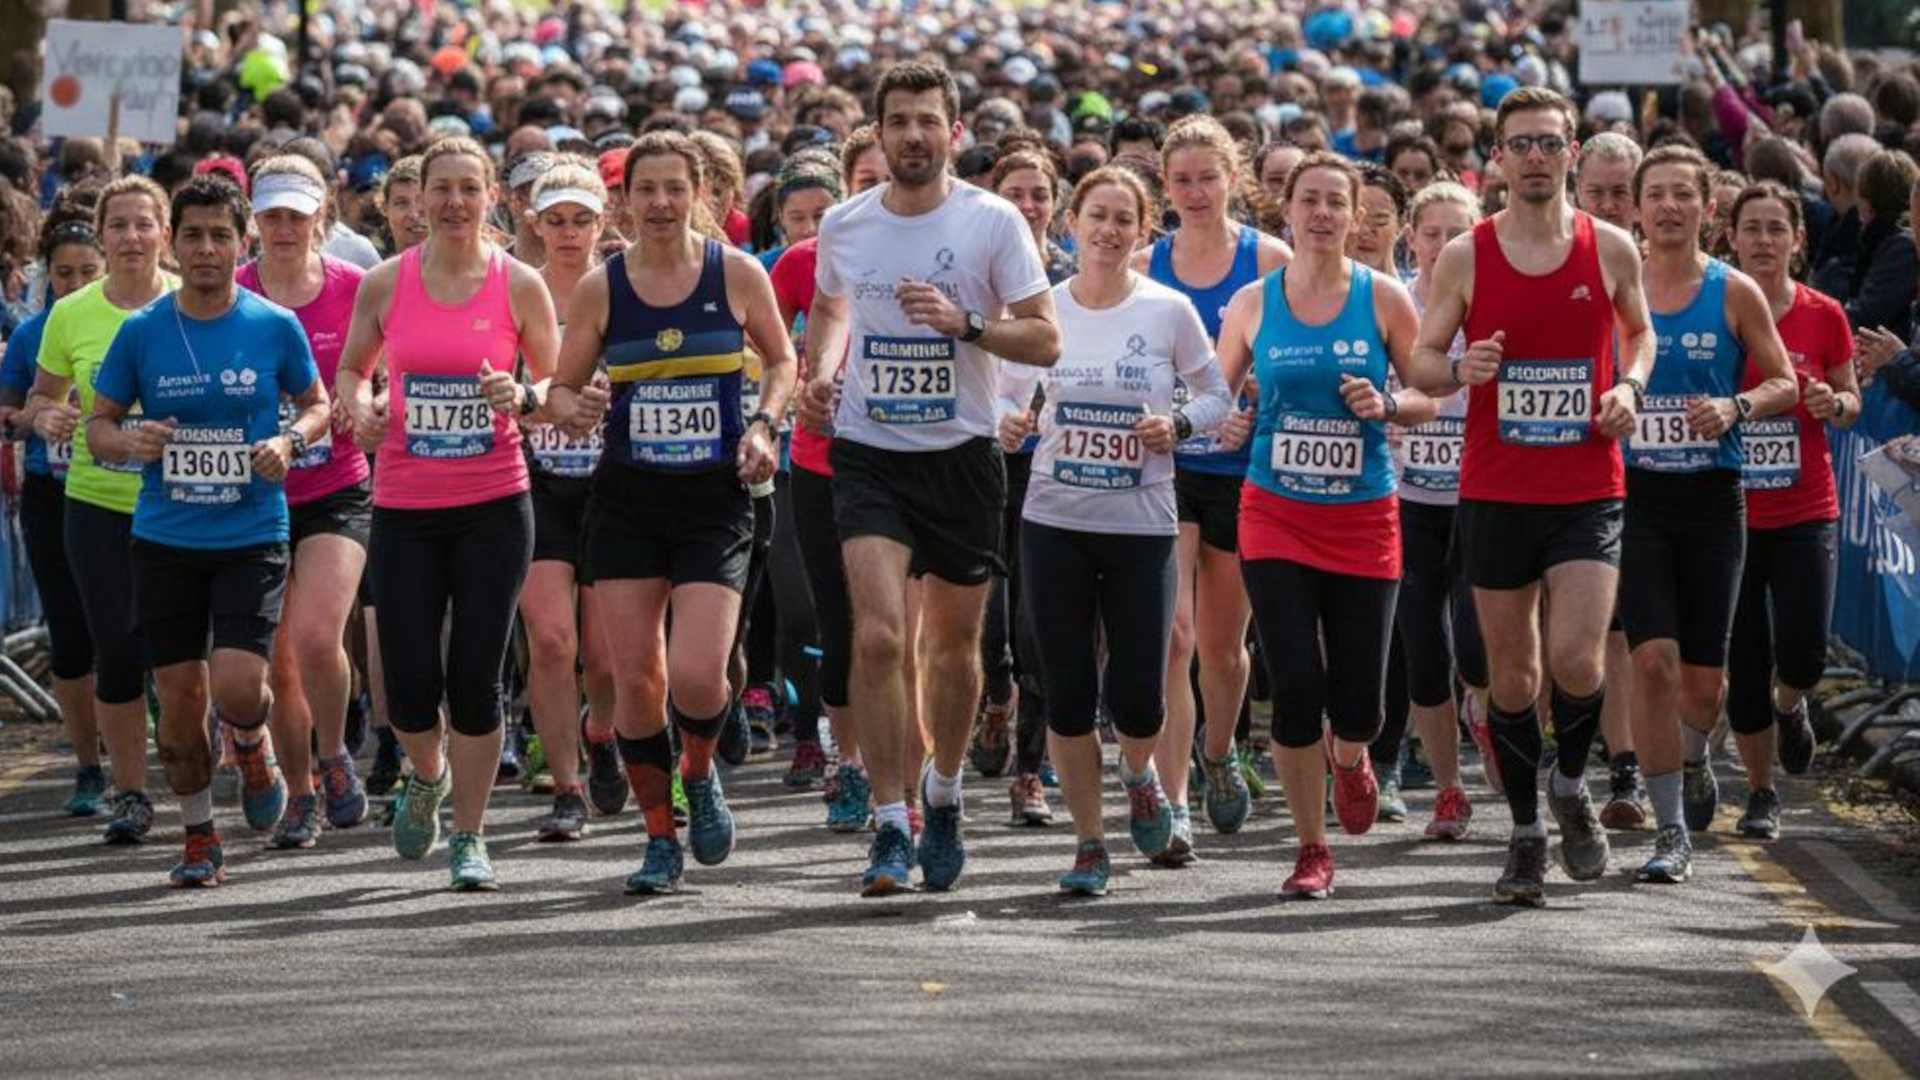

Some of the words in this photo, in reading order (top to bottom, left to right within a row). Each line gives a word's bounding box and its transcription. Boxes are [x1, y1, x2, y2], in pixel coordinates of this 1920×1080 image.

[1506, 388, 1586, 417] 13720
[637, 406, 716, 434] 11340
[1061, 430, 1139, 461] 17590
